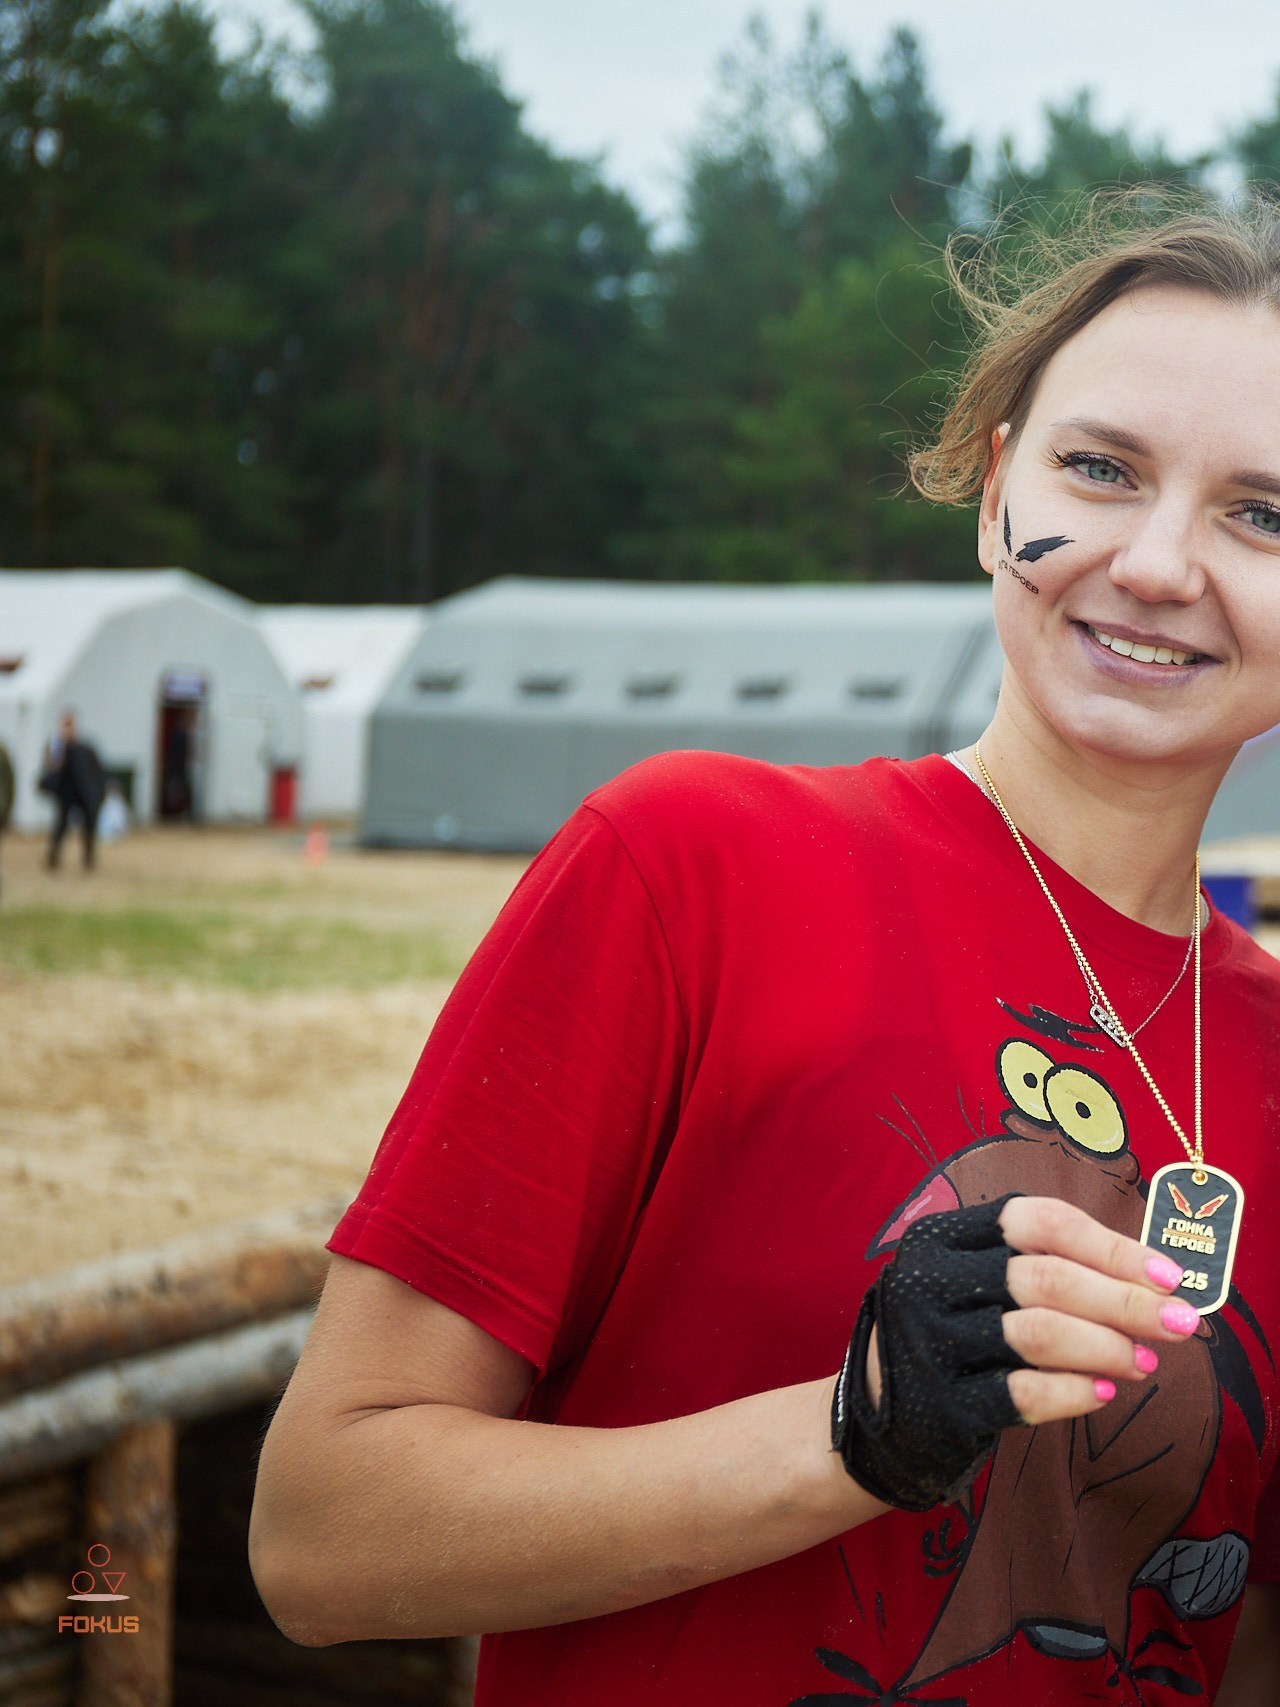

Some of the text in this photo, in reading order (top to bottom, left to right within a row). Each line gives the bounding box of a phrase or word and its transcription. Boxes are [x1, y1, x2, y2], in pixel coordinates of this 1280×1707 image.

[1167, 1217, 1214, 1238] ГОНКА
[1161, 1233, 1216, 1255] ГЕРОЕВ
[1180, 1269, 1209, 1291] 25
